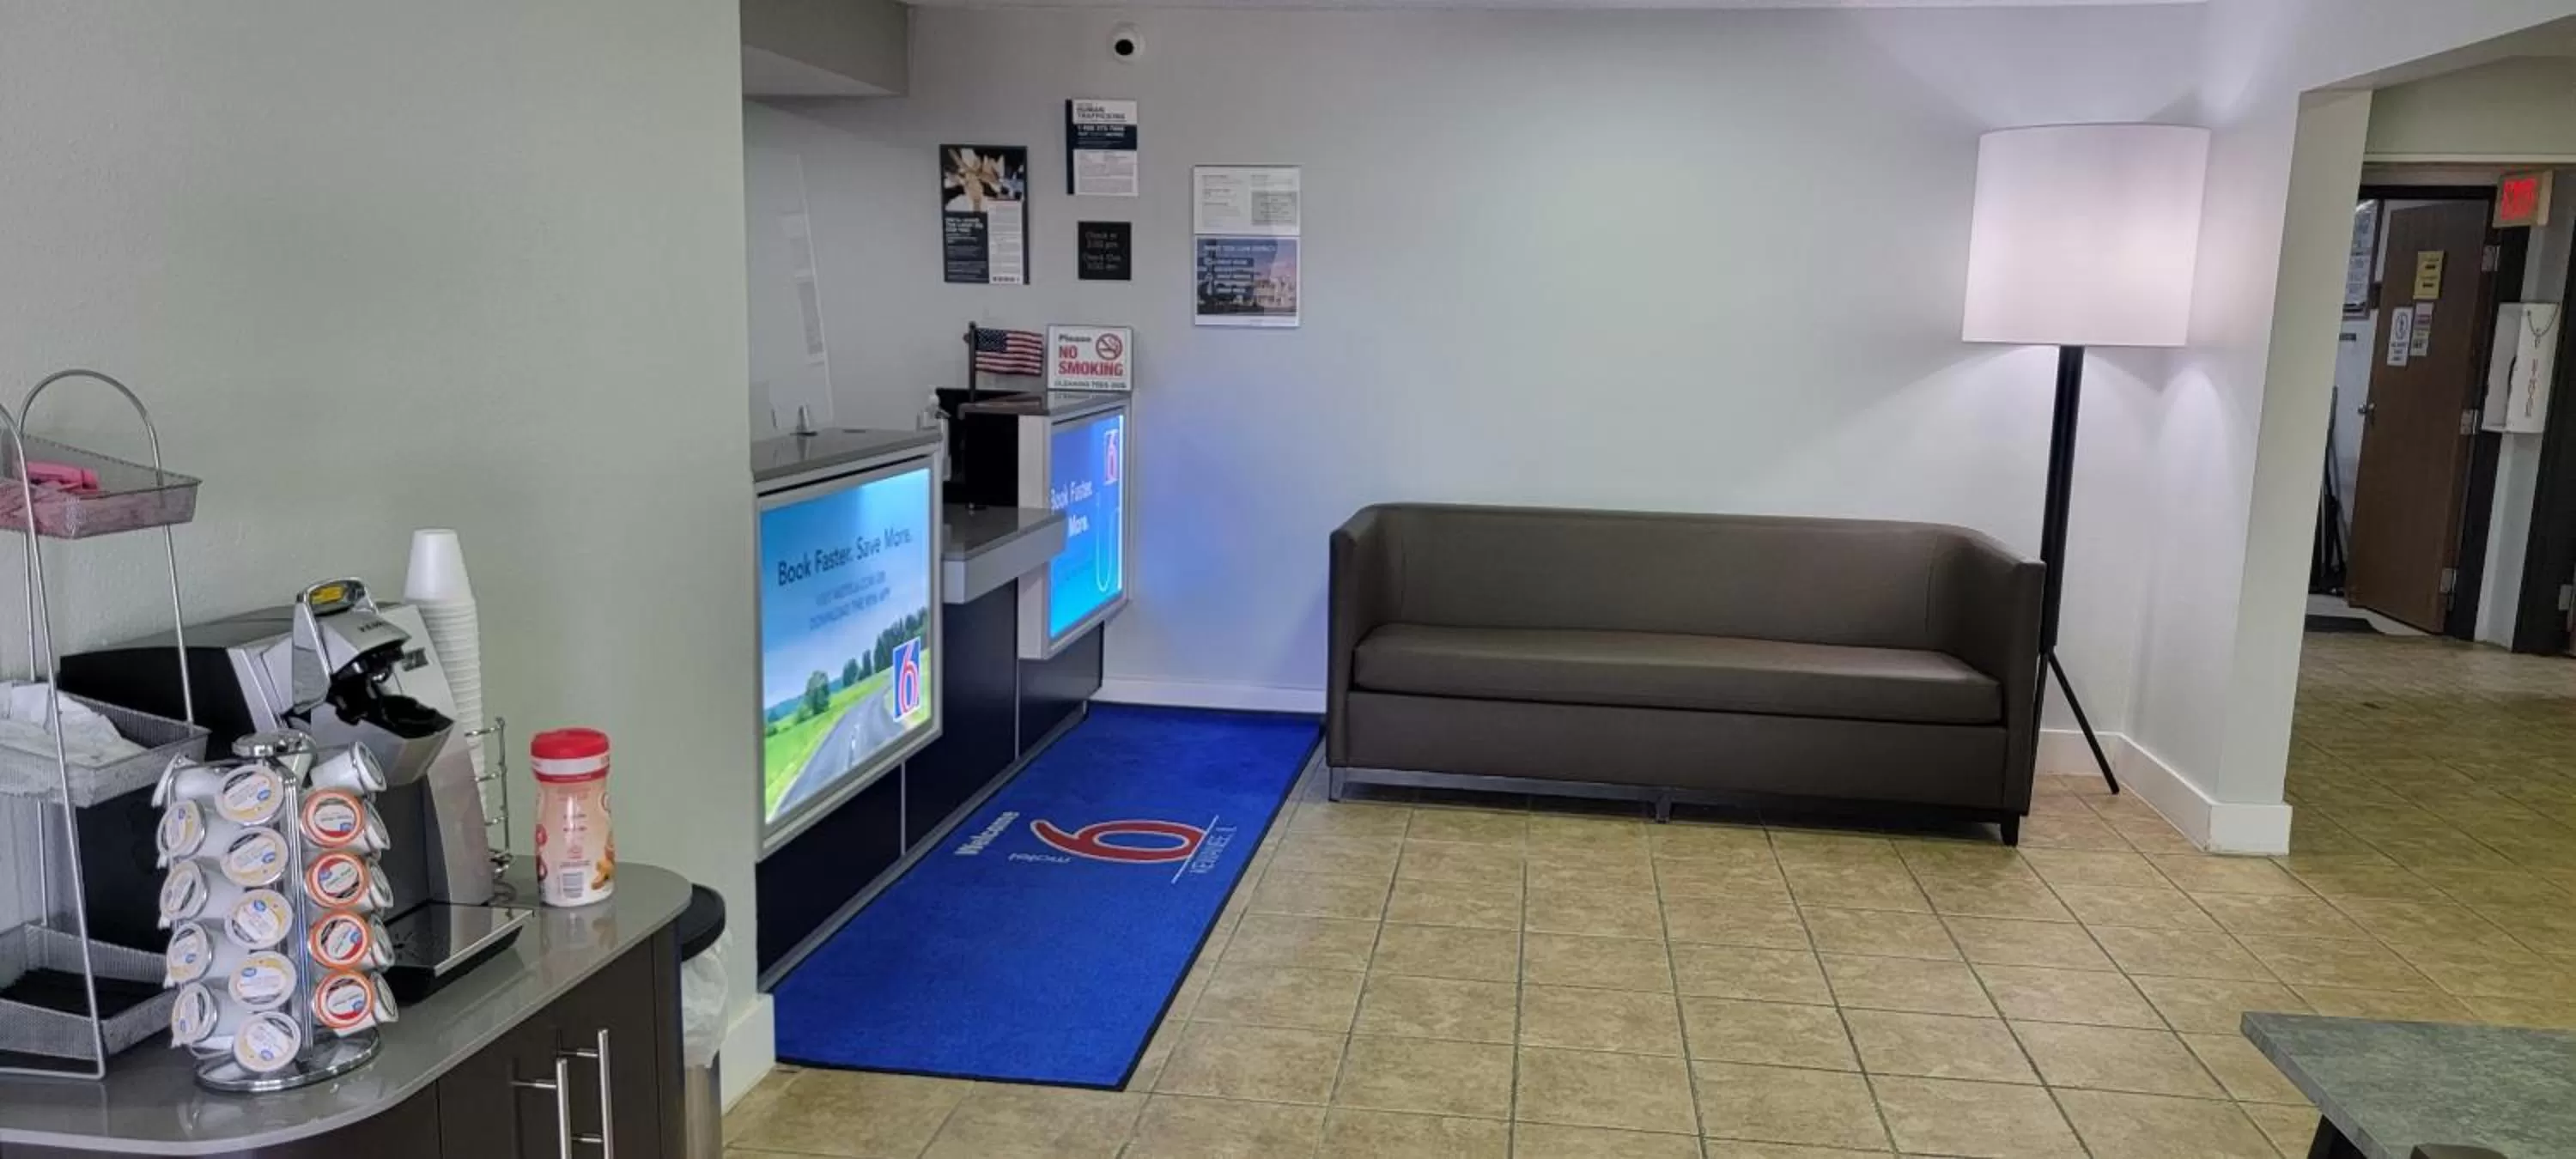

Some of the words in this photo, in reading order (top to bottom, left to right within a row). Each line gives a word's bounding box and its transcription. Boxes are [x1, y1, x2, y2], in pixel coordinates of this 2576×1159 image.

[1058, 345, 1078, 359] NO
[1059, 333, 1091, 342] Please
[1058, 361, 1124, 377] SMOKING
[778, 551, 811, 586] Book
[814, 547, 854, 574] Faster.
[855, 535, 881, 561] Save
[898, 641, 919, 714] 6
[954, 811, 1020, 856] Welcome
[1030, 819, 1207, 864] 6
